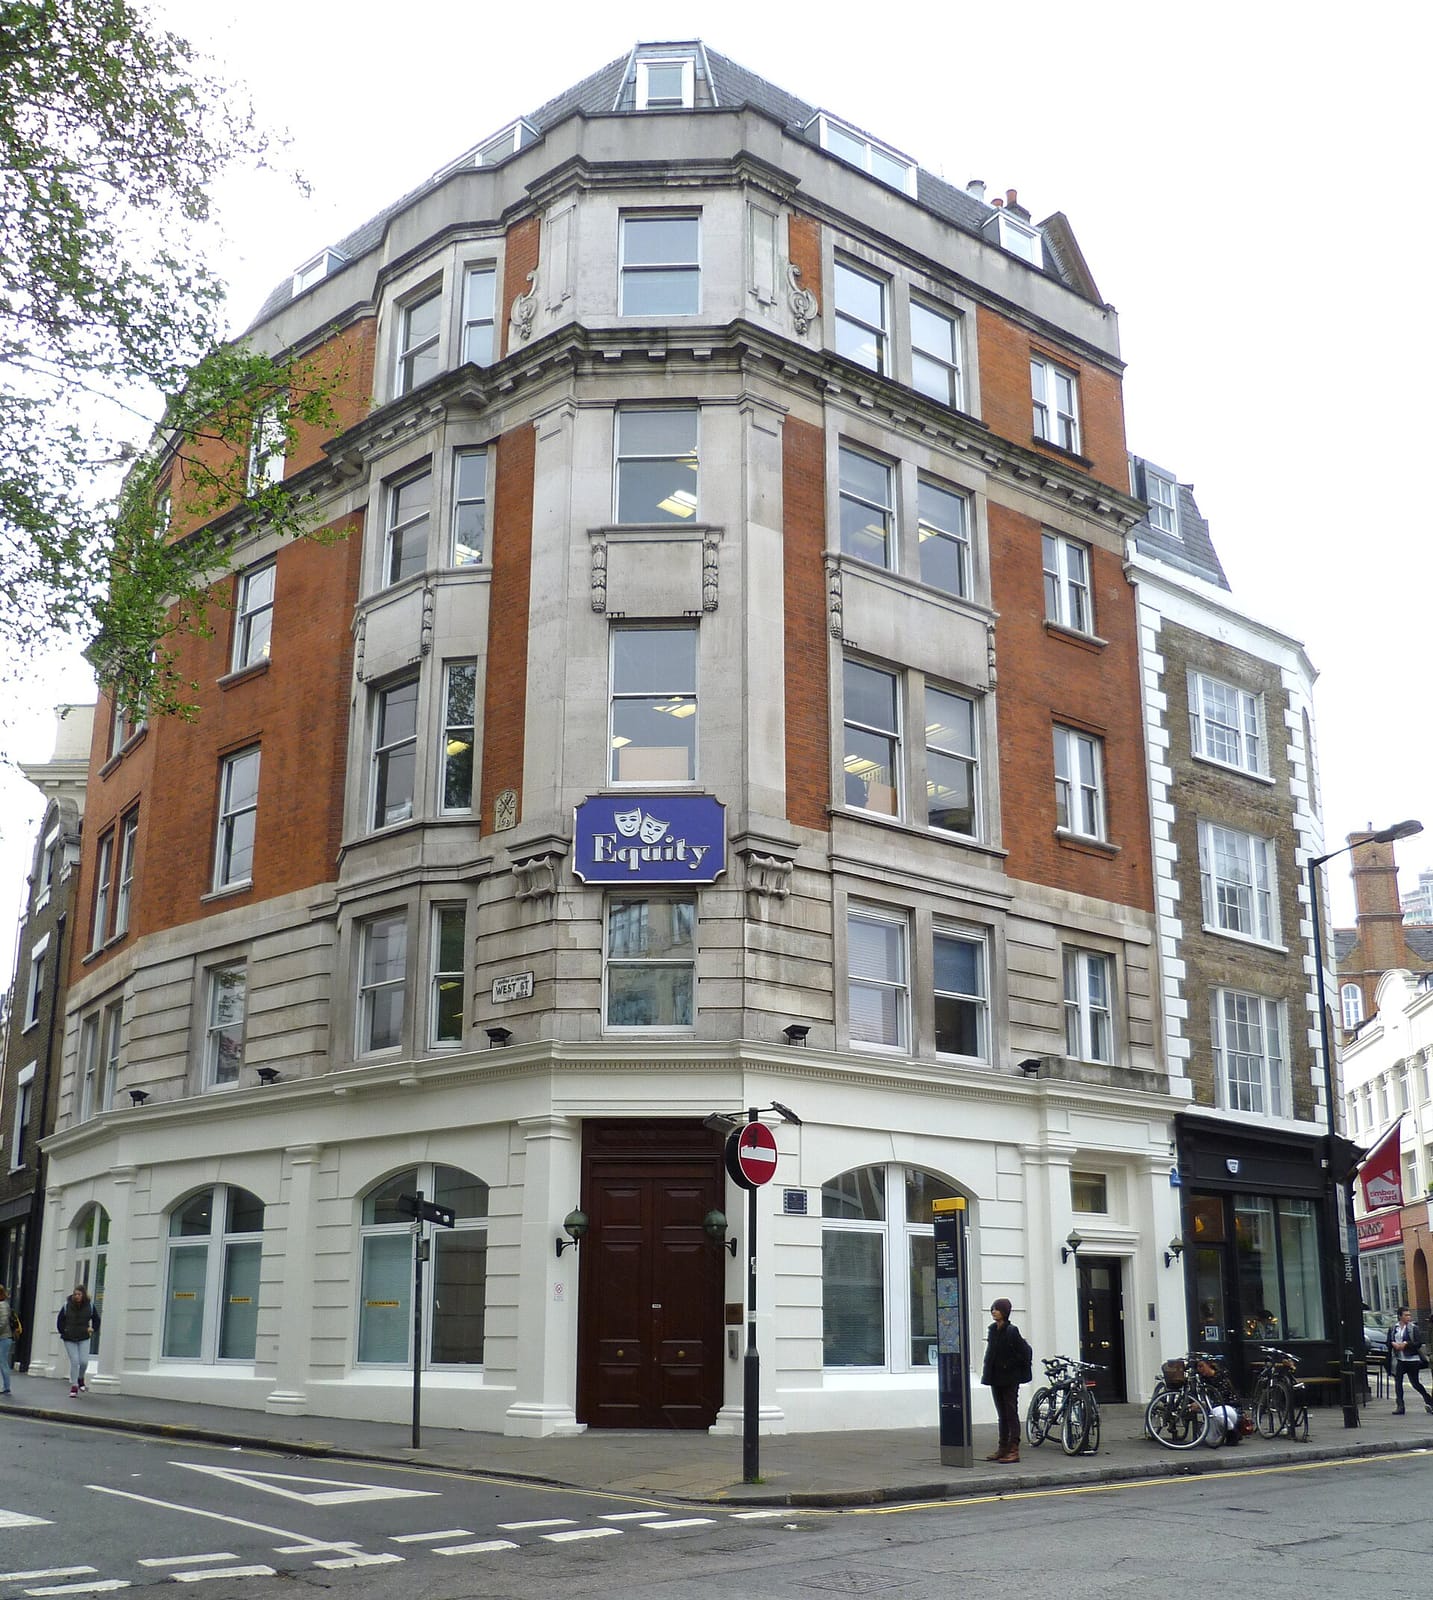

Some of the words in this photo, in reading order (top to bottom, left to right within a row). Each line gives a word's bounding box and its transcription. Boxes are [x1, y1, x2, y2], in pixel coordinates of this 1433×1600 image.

[592, 833, 710, 871] Equity
[496, 983, 517, 995] WEST
[520, 980, 529, 990] ST
[1370, 1189, 1395, 1197] timber
[1379, 1194, 1397, 1202] yard
